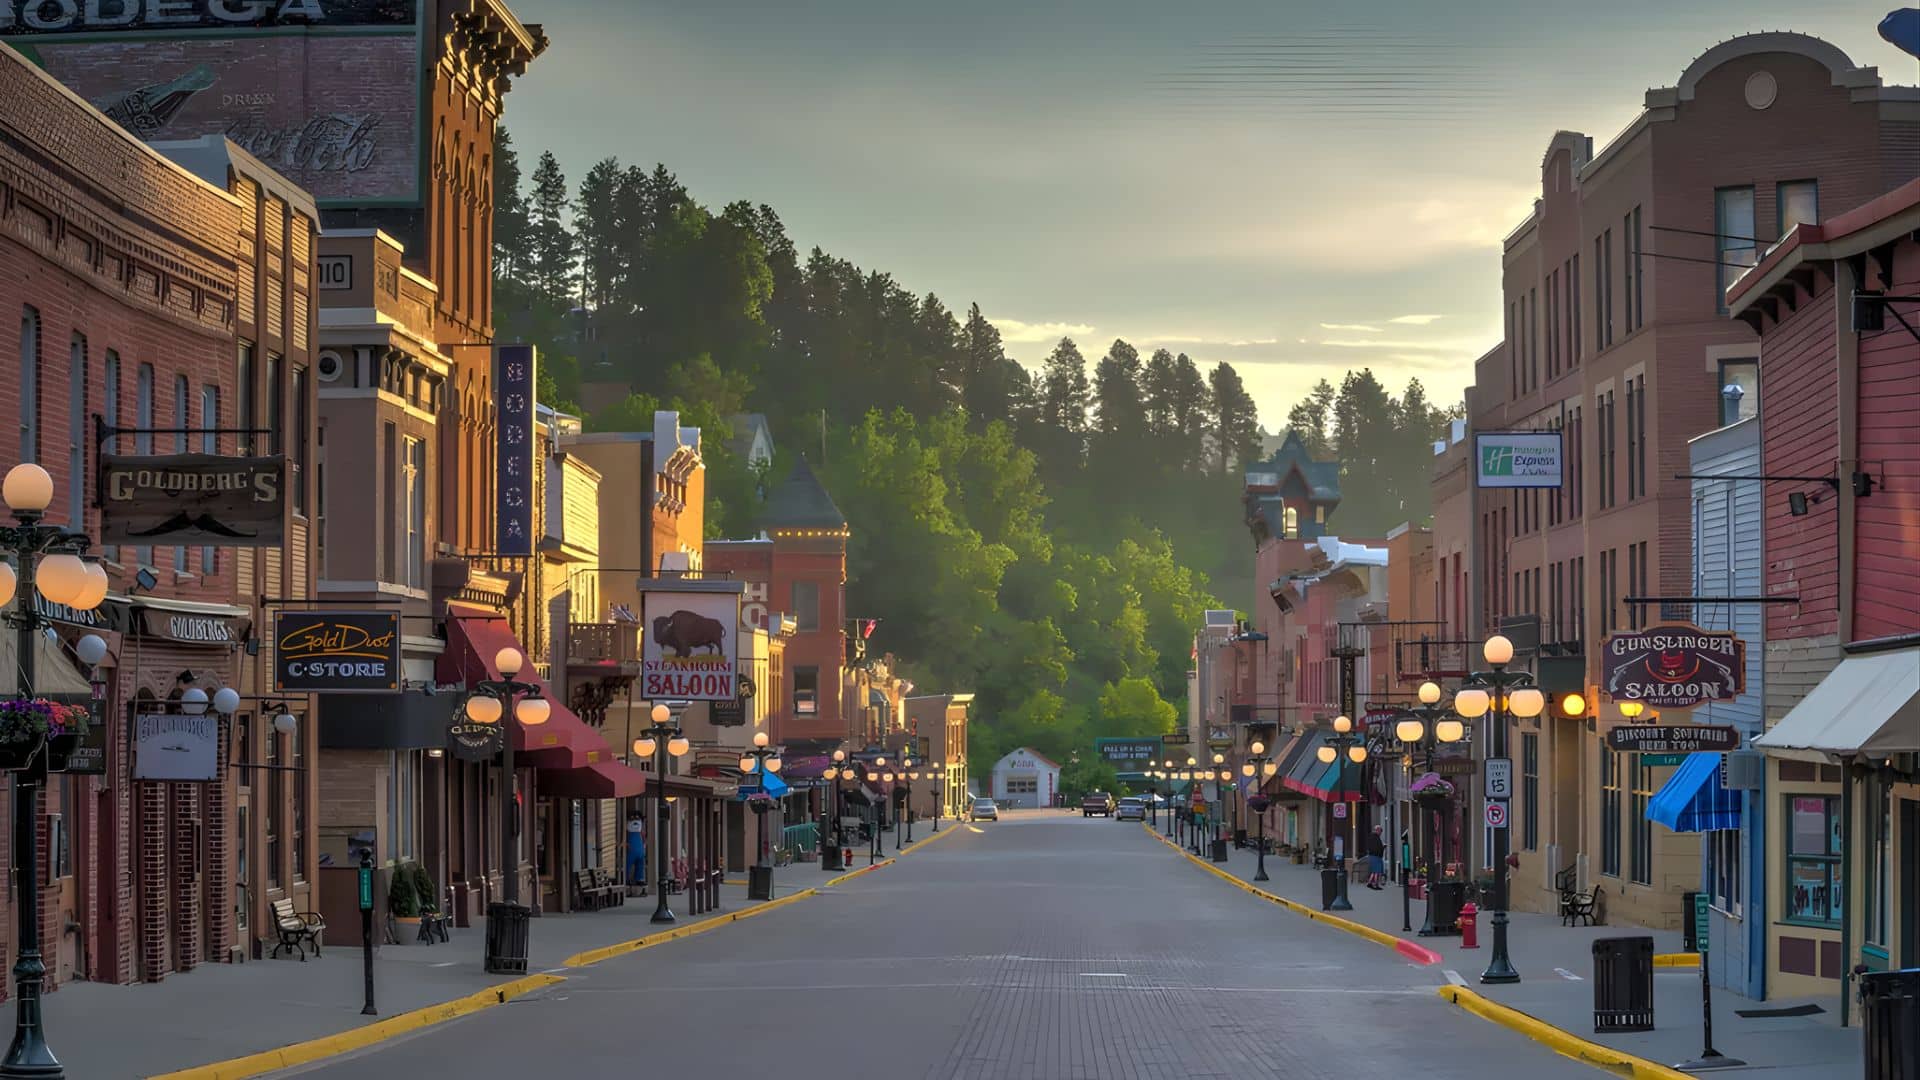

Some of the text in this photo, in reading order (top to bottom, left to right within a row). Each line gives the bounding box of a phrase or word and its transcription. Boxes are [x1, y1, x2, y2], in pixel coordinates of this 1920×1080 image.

[0, 0, 327, 29] ODEGA
[506, 362, 524, 539] BODEGA
[110, 466, 277, 502] GOLDBERG'S
[280, 622, 395, 652] Gold Dust
[1612, 635, 1735, 656] GUNSLINGER
[647, 674, 731, 697] SALOON
[1625, 682, 1721, 699] SALOON
[1492, 780, 1505, 792] 15
